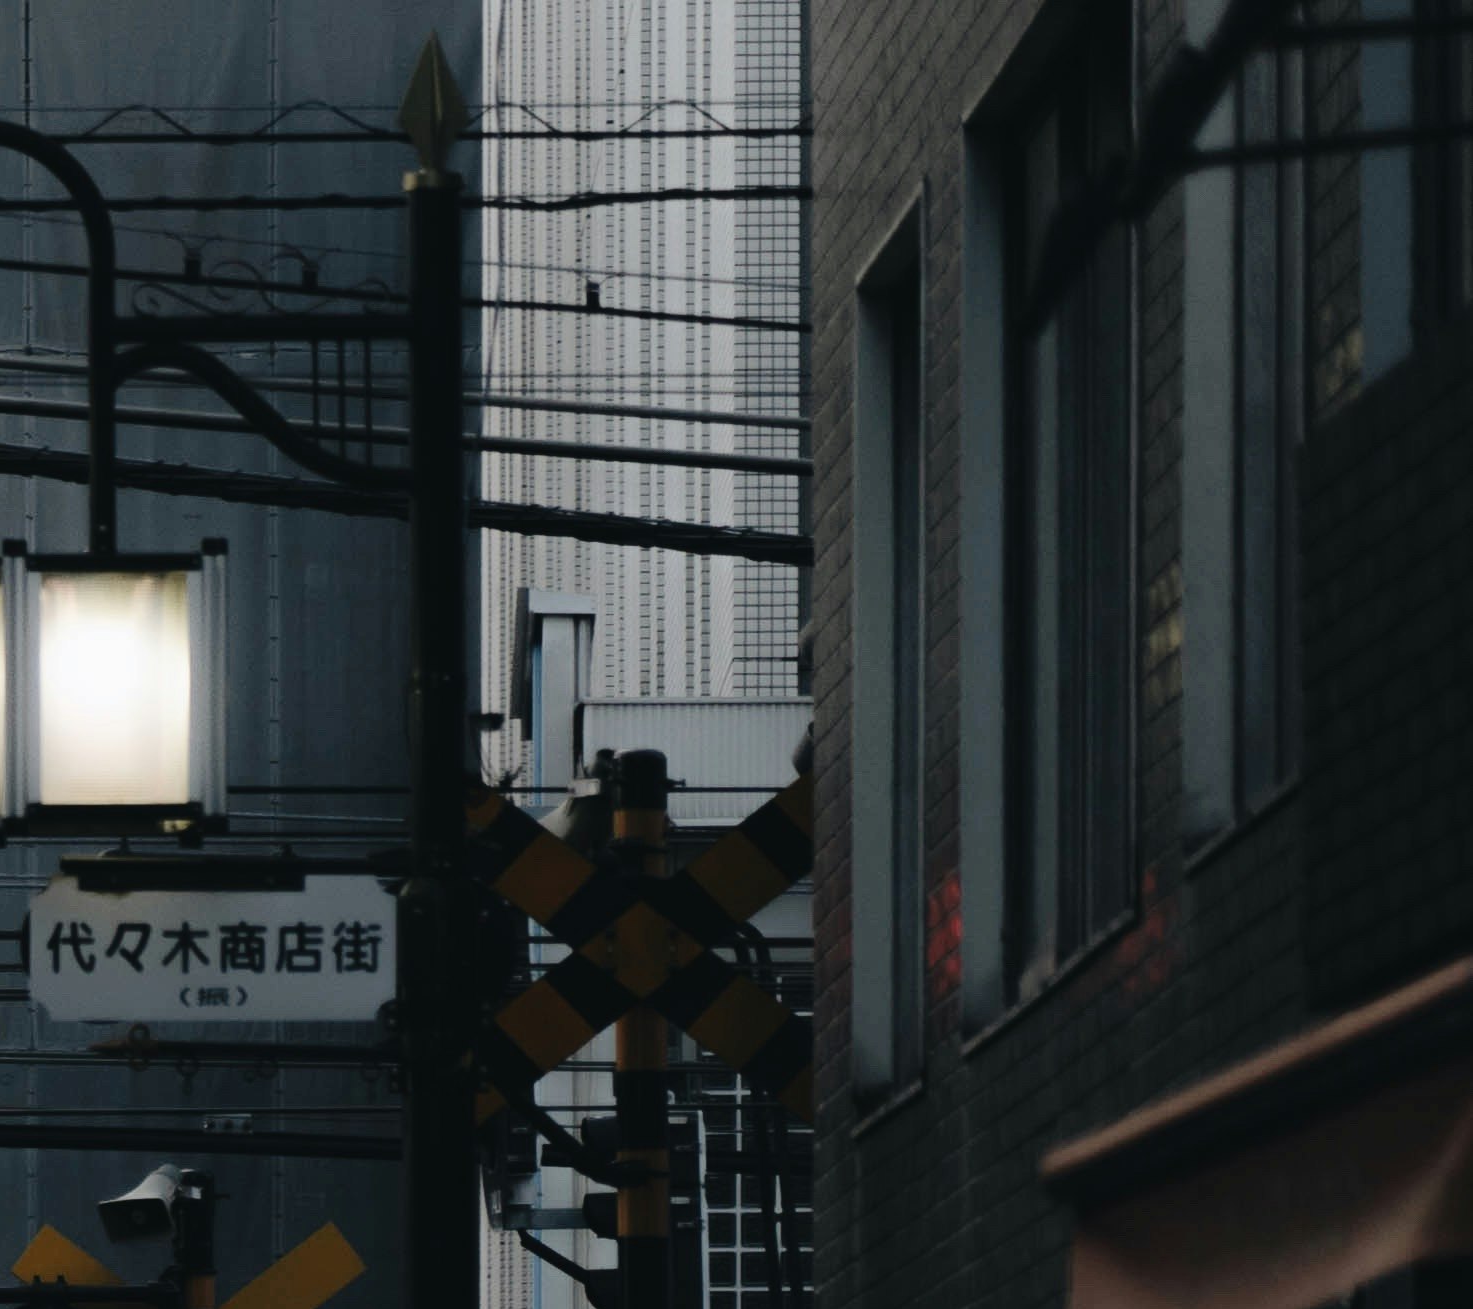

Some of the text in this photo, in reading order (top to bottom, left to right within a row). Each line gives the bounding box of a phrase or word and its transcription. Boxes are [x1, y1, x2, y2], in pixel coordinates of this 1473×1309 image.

[46, 921, 383, 975] 代々木商店街
